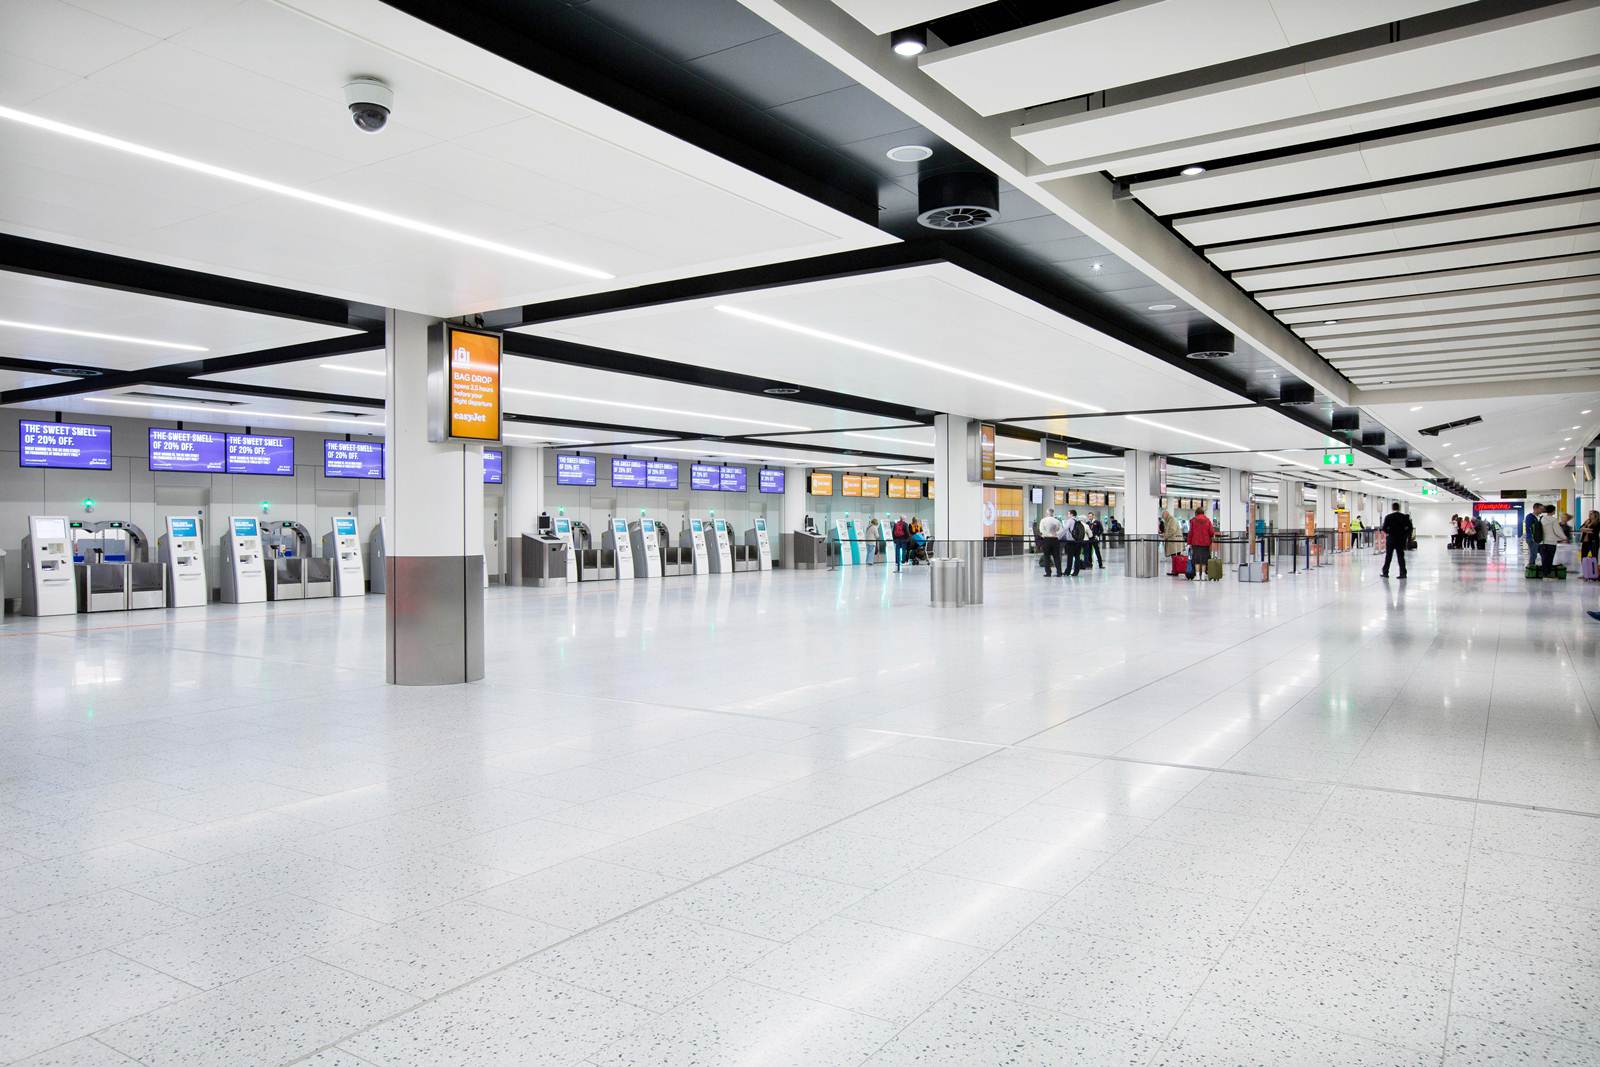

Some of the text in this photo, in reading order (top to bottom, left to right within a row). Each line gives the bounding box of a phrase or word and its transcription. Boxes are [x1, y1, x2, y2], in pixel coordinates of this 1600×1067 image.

[454, 372, 492, 383] BAG DROP
[454, 413, 486, 422] easyJet
[25, 424, 96, 437] THE SWEET SMELL
[25, 435, 34, 443] OF
[38, 435, 56, 444] 20%
[153, 432, 213, 443] THE SWEET SMELL
[230, 436, 283, 447] THE SWEET SMELL
[153, 441, 161, 449] OF
[164, 441, 179, 450] 20%
[239, 446, 252, 454] 20%
